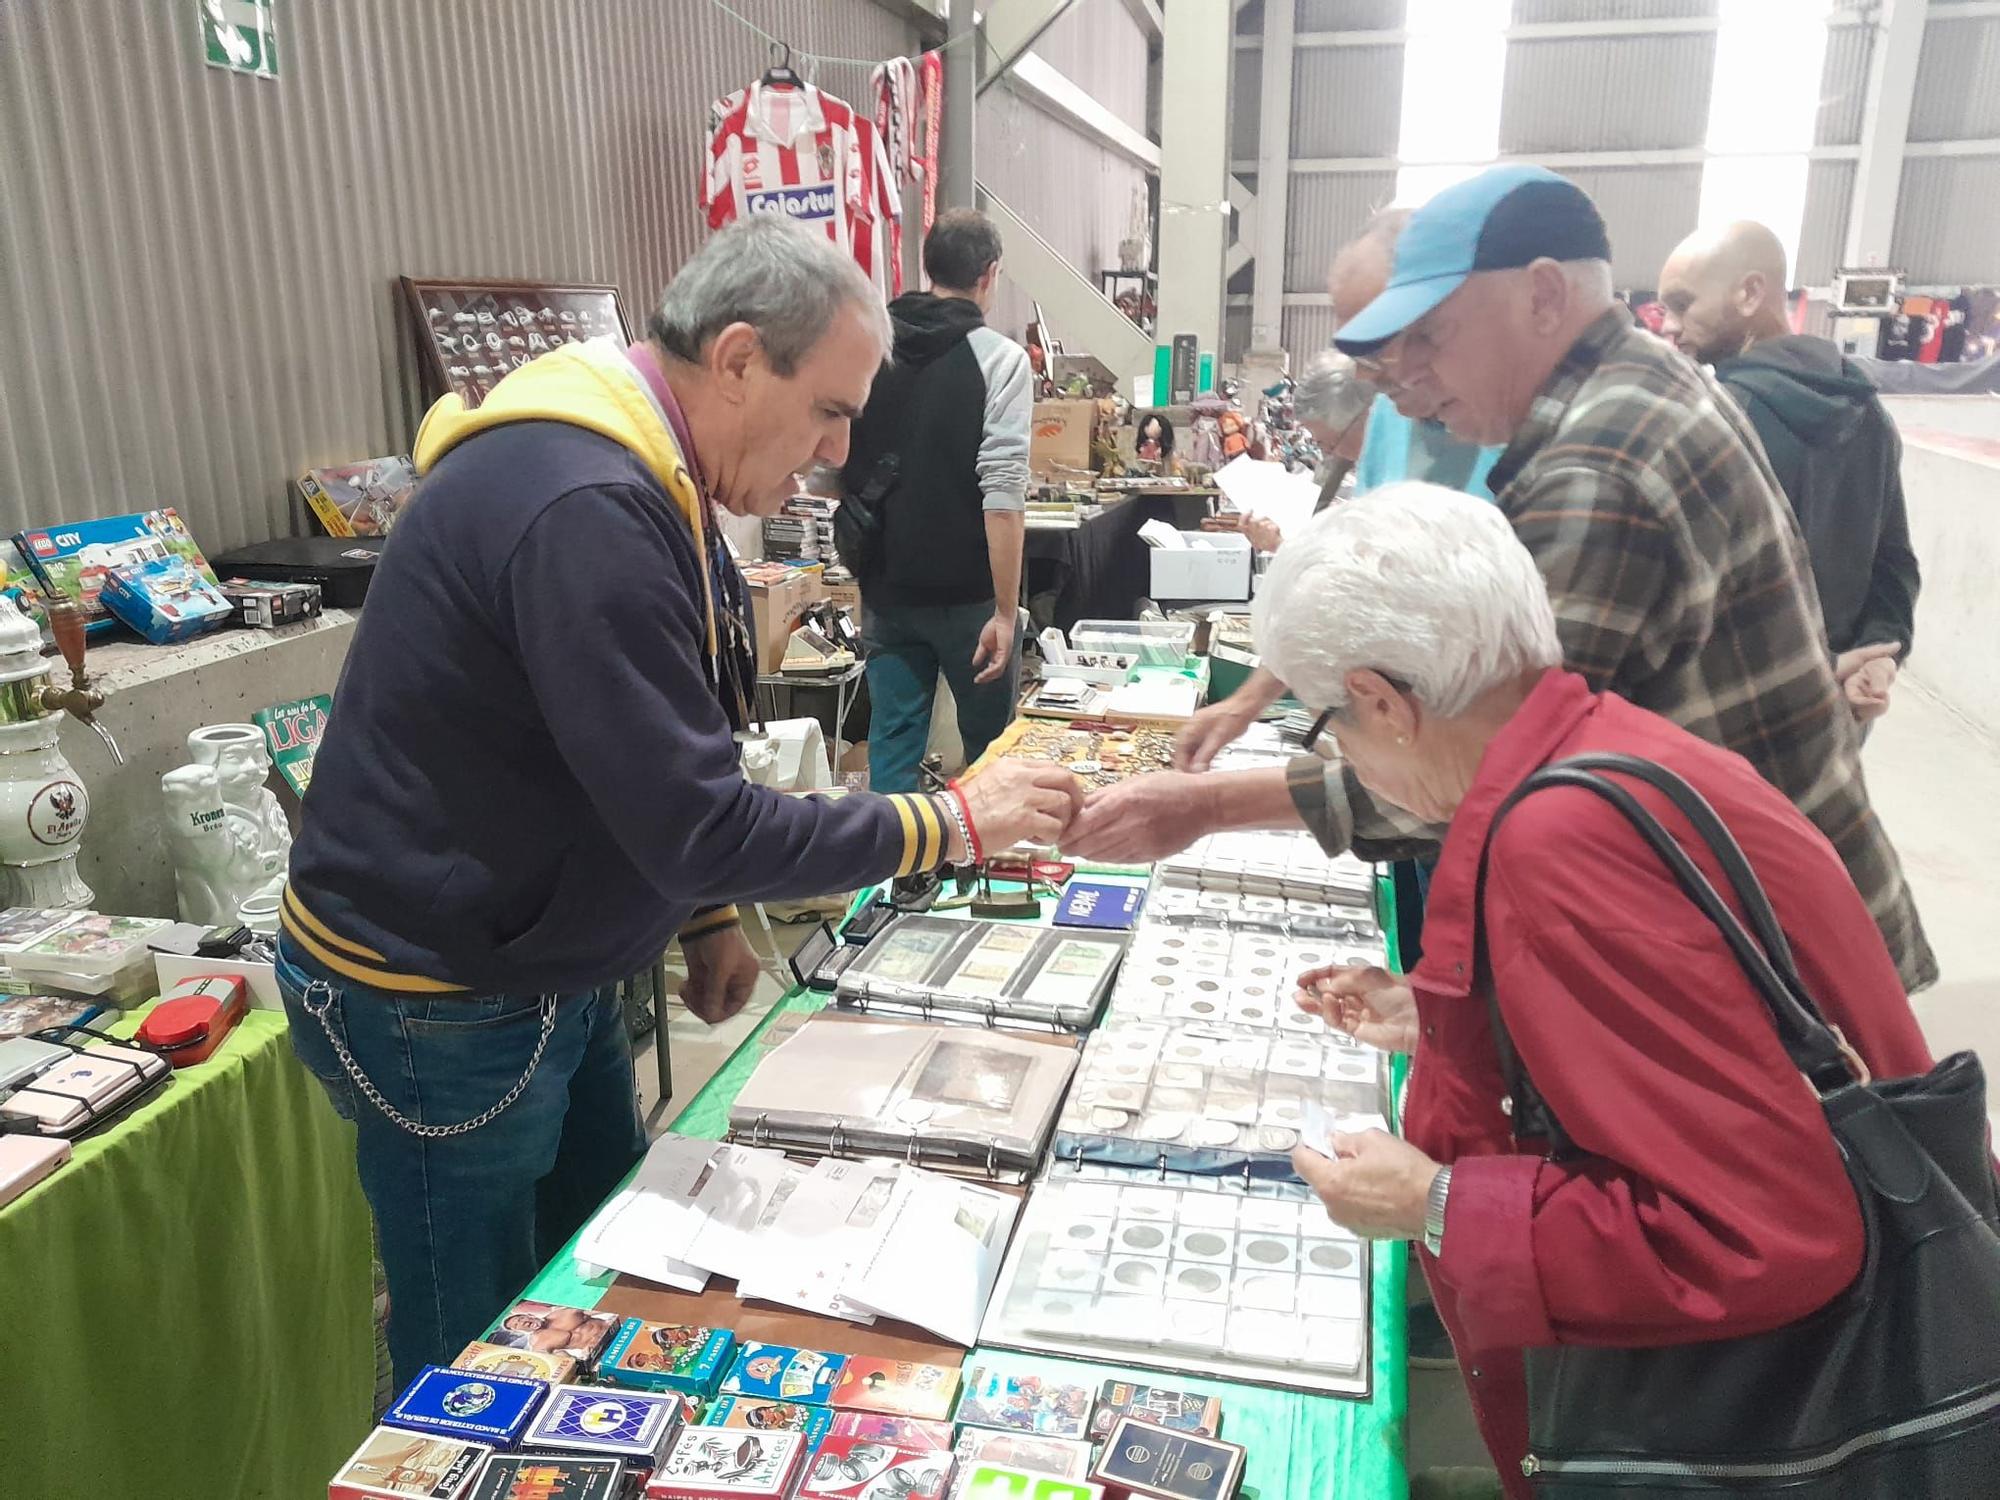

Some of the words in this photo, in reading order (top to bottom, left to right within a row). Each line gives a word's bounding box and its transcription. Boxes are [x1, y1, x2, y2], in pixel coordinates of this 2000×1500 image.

[55, 532, 82, 547] CITY
[265, 708, 328, 752] LIGA
[605, 1330, 631, 1365] FAMILIAS
[440, 1368, 464, 1377] BANCO
[464, 1371, 498, 1382] EXTERIOR
[498, 1375, 507, 1383] DE
[440, 1418, 476, 1431] EXTERIOR
[475, 1424, 500, 1434] BANCO
[665, 1434, 698, 1476] Cafés
[753, 1437, 789, 1484] Areces
[439, 1469, 459, 1494] Long
[454, 1454, 472, 1474] John
